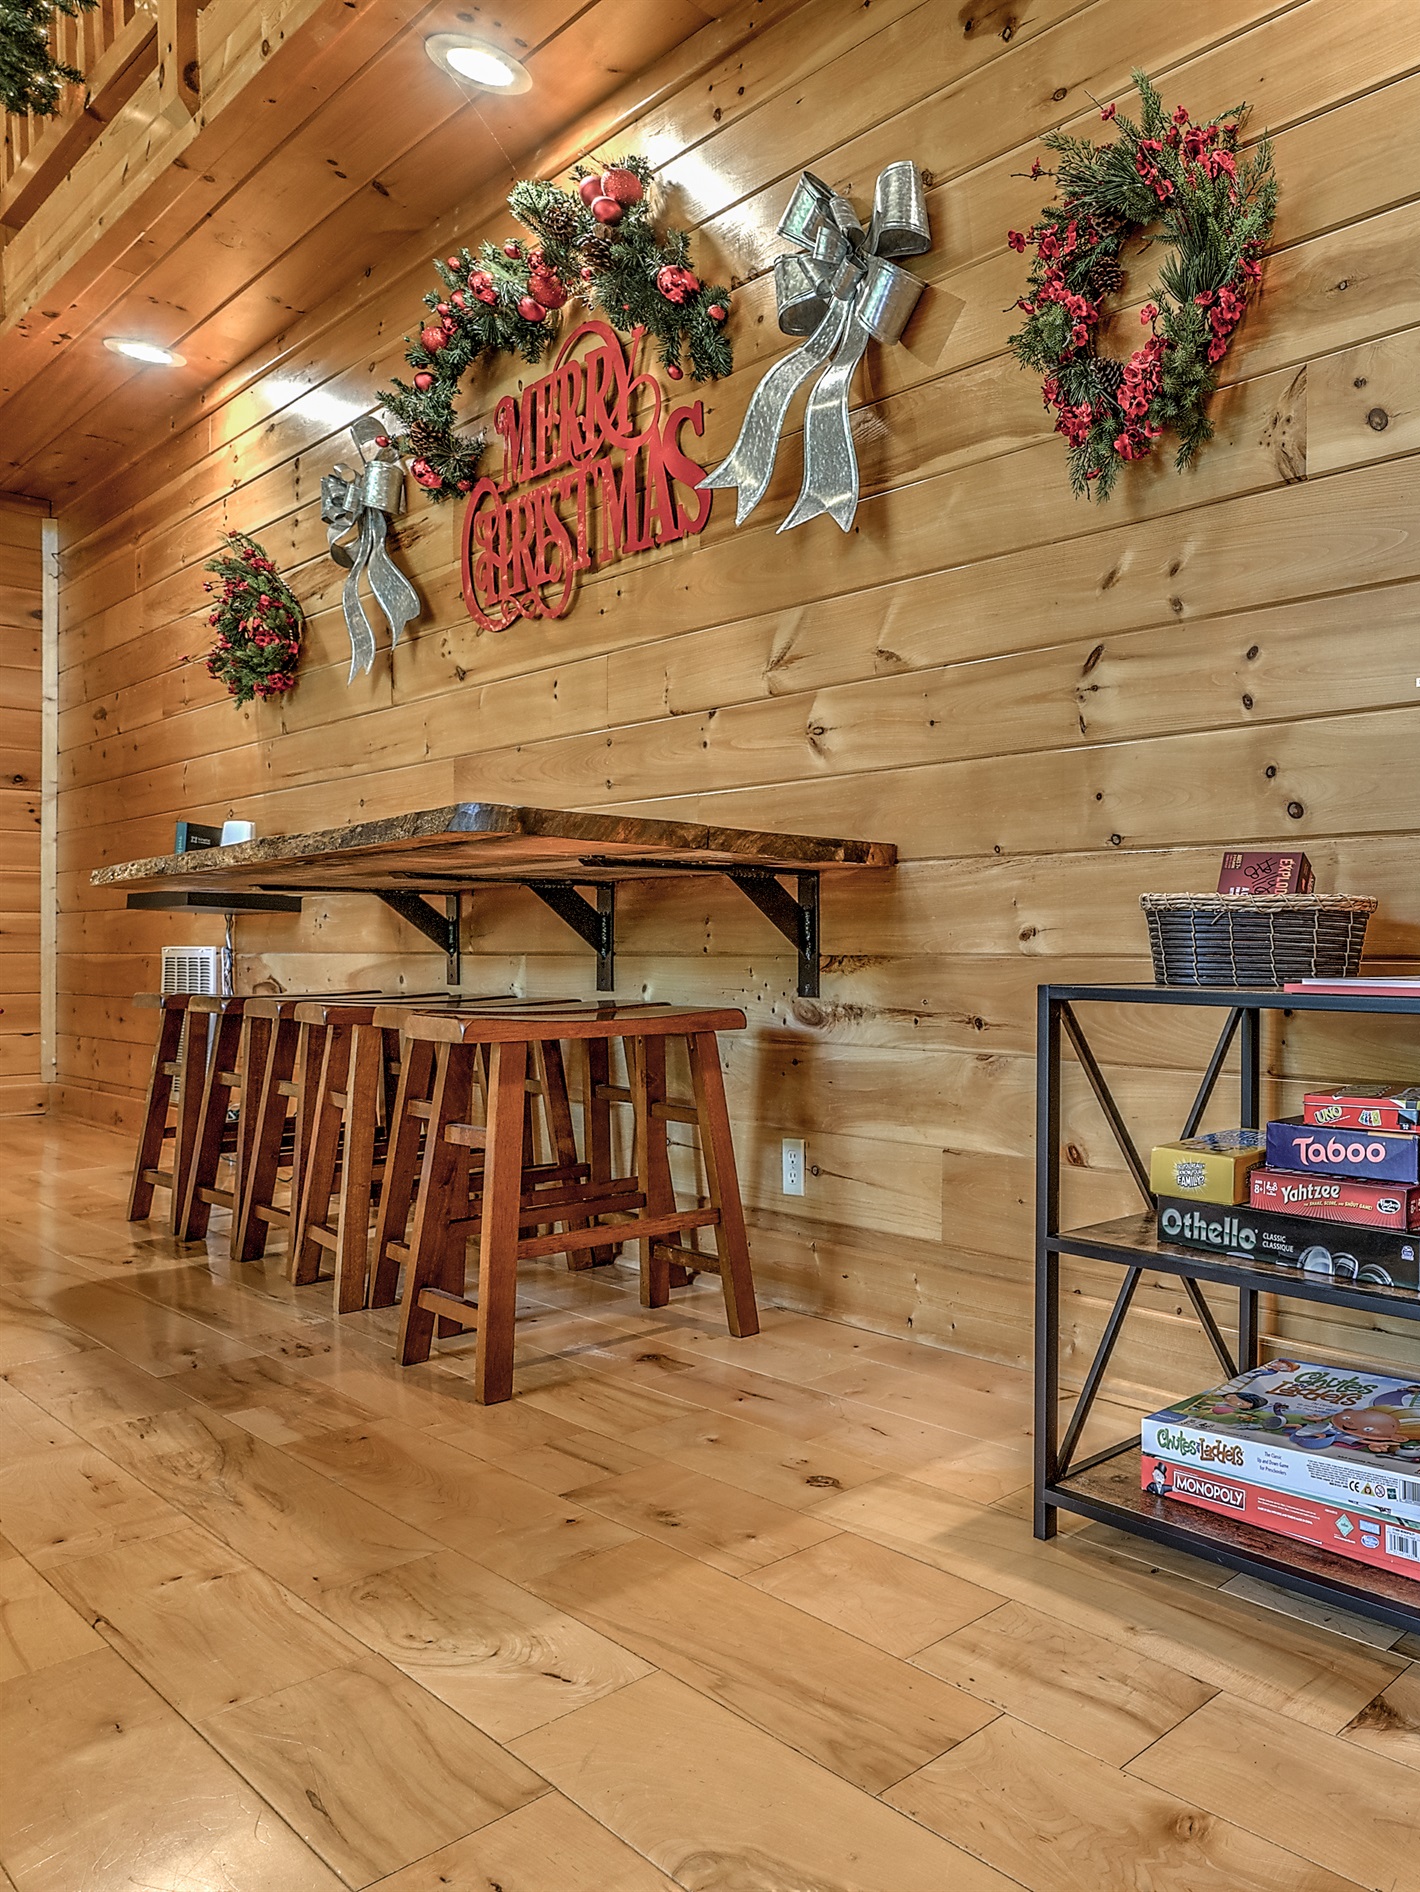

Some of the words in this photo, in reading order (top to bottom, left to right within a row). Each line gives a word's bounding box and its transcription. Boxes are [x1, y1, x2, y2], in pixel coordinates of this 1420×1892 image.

[493, 320, 662, 494] MERRY
[461, 399, 713, 633] CHRISTMAS
[1314, 1106, 1343, 1124] UNO
[1292, 1135, 1386, 1166] Taboo
[1177, 1175, 1205, 1187] FAMILY?
[1280, 1183, 1341, 1204] Yahtzee
[1161, 1207, 1257, 1250] Othello
[1262, 1232, 1287, 1243] CLASSIC
[1262, 1241, 1294, 1253] CLASSIQUE
[1265, 1380, 1364, 1406] Ladders
[1294, 1371, 1379, 1395] Chutes
[1157, 1427, 1197, 1456] Chutes
[1199, 1437, 1244, 1466] Ladders
[1270, 1452, 1283, 1460] Classic
[1265, 1466, 1287, 1476] Preschoolers
[1279, 1461, 1290, 1469] Game
[1176, 1474, 1244, 1507] MONOPOLY
